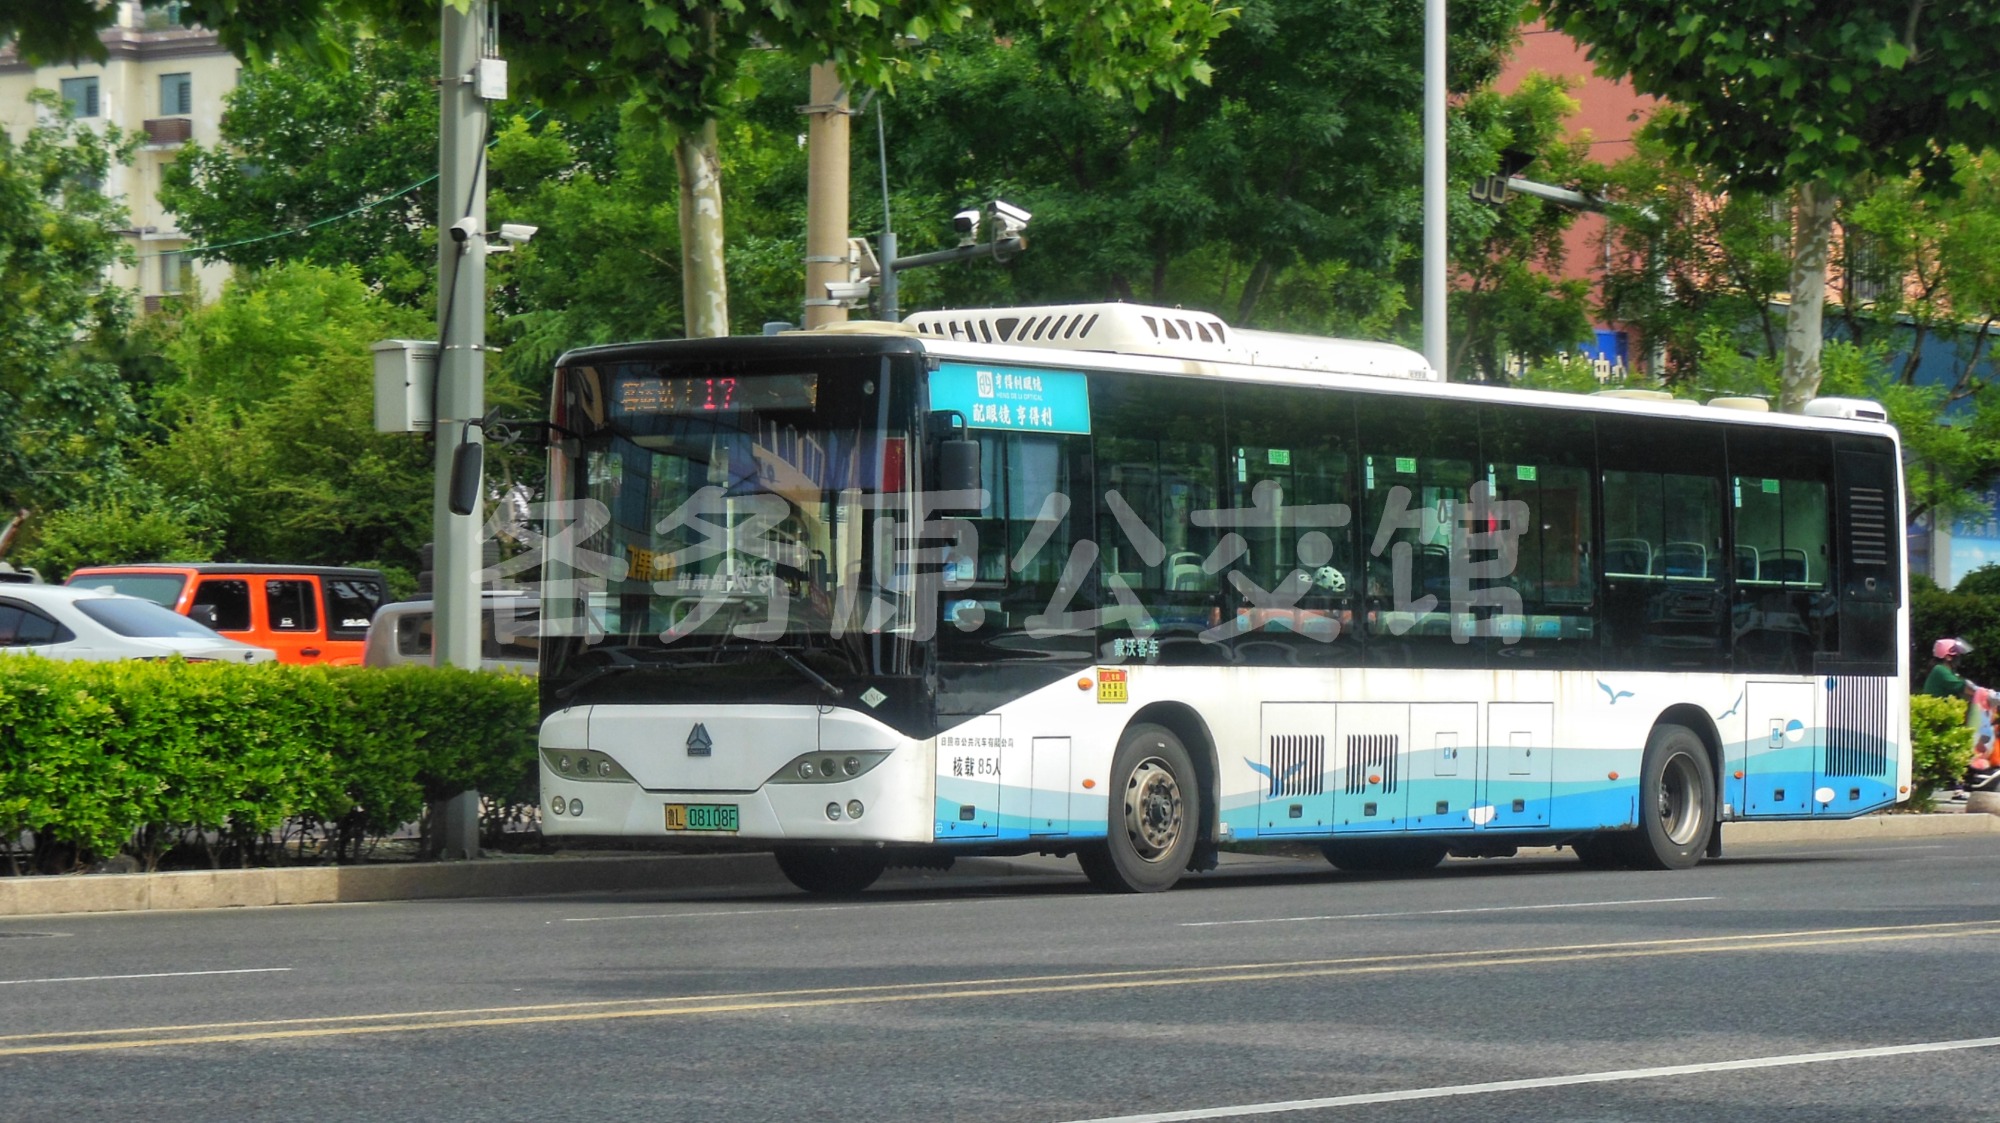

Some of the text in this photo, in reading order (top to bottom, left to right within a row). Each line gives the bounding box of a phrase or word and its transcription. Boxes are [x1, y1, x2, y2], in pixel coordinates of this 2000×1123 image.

[995, 373, 1043, 391] 亨得利眼镜
[704, 378, 736, 410] 17
[973, 403, 1052, 427] 配眼镜 亨得利
[1113, 638, 1159, 658] 豪沃客车
[940, 737, 1014, 748] 日照市公共汽车有限公司
